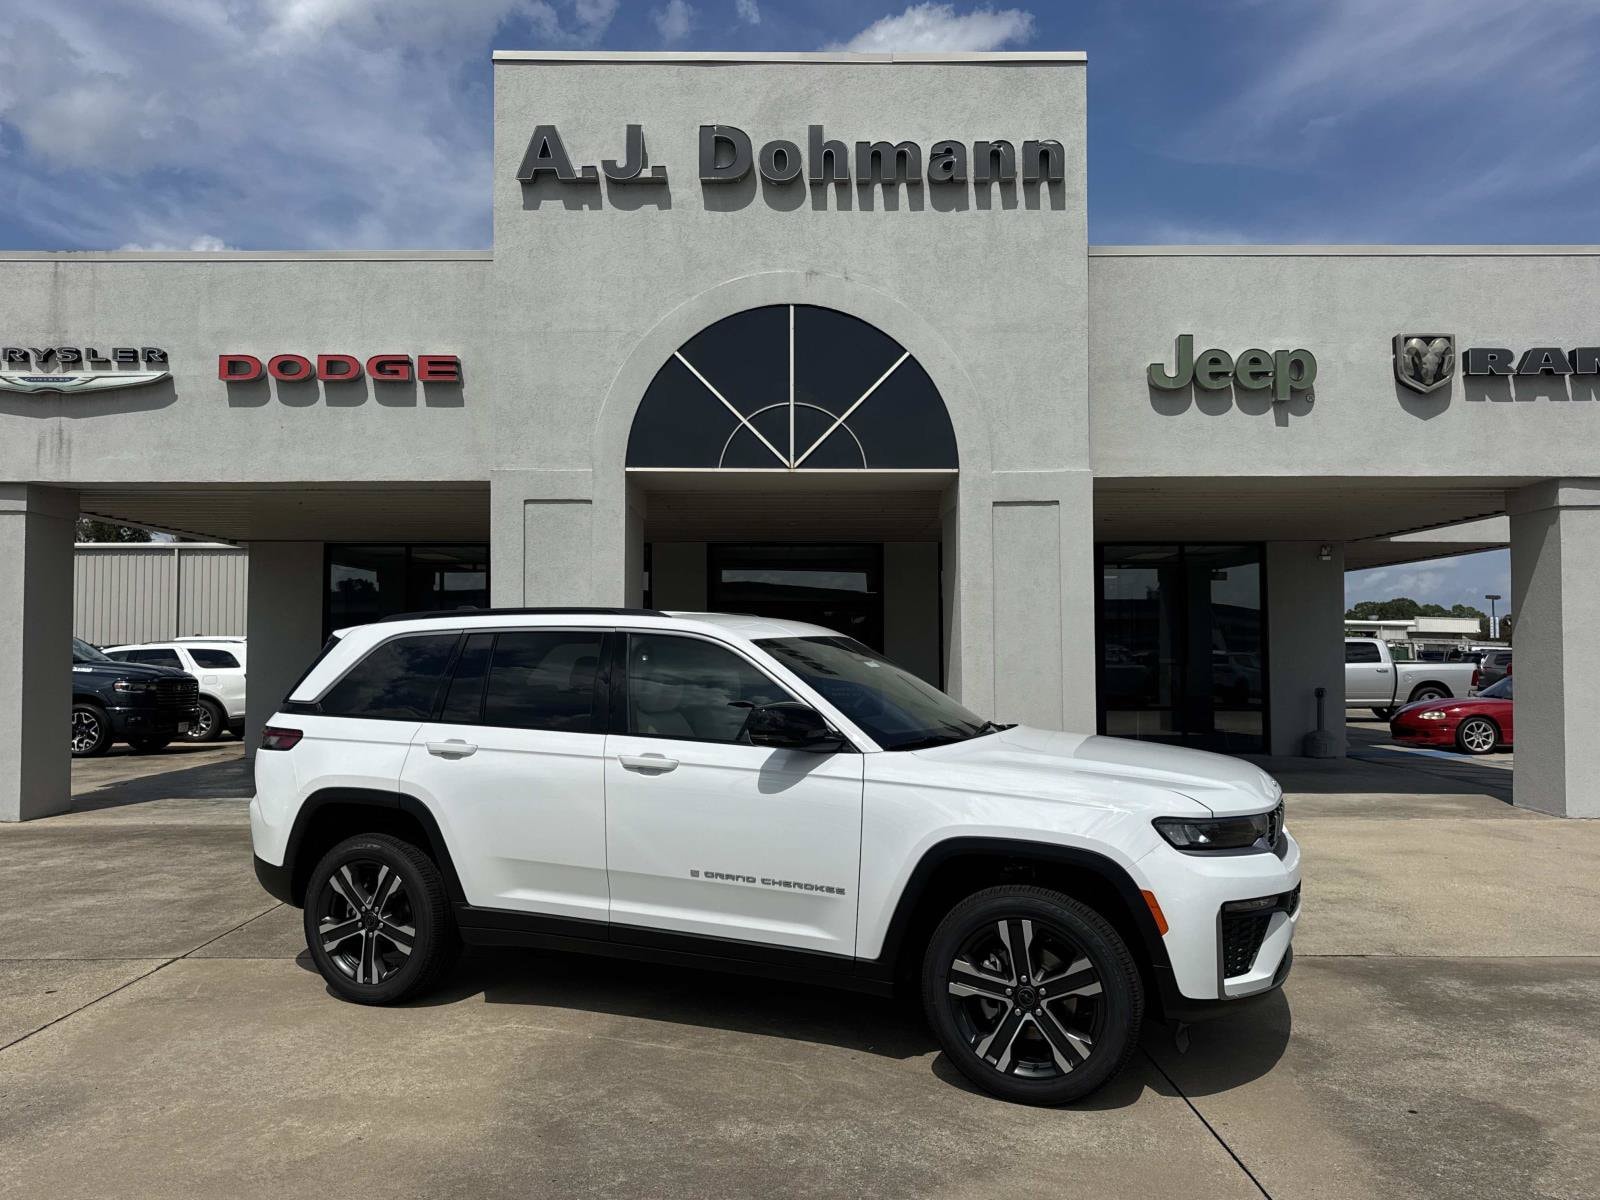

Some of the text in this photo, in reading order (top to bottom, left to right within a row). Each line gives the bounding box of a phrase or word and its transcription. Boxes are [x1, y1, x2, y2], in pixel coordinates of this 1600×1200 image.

[516, 125, 1065, 184] A.J. Dohmann
[218, 354, 460, 382] DODGE
[1148, 334, 1317, 401] Jeep
[704, 871, 845, 895] GRAND CHEROKEE
